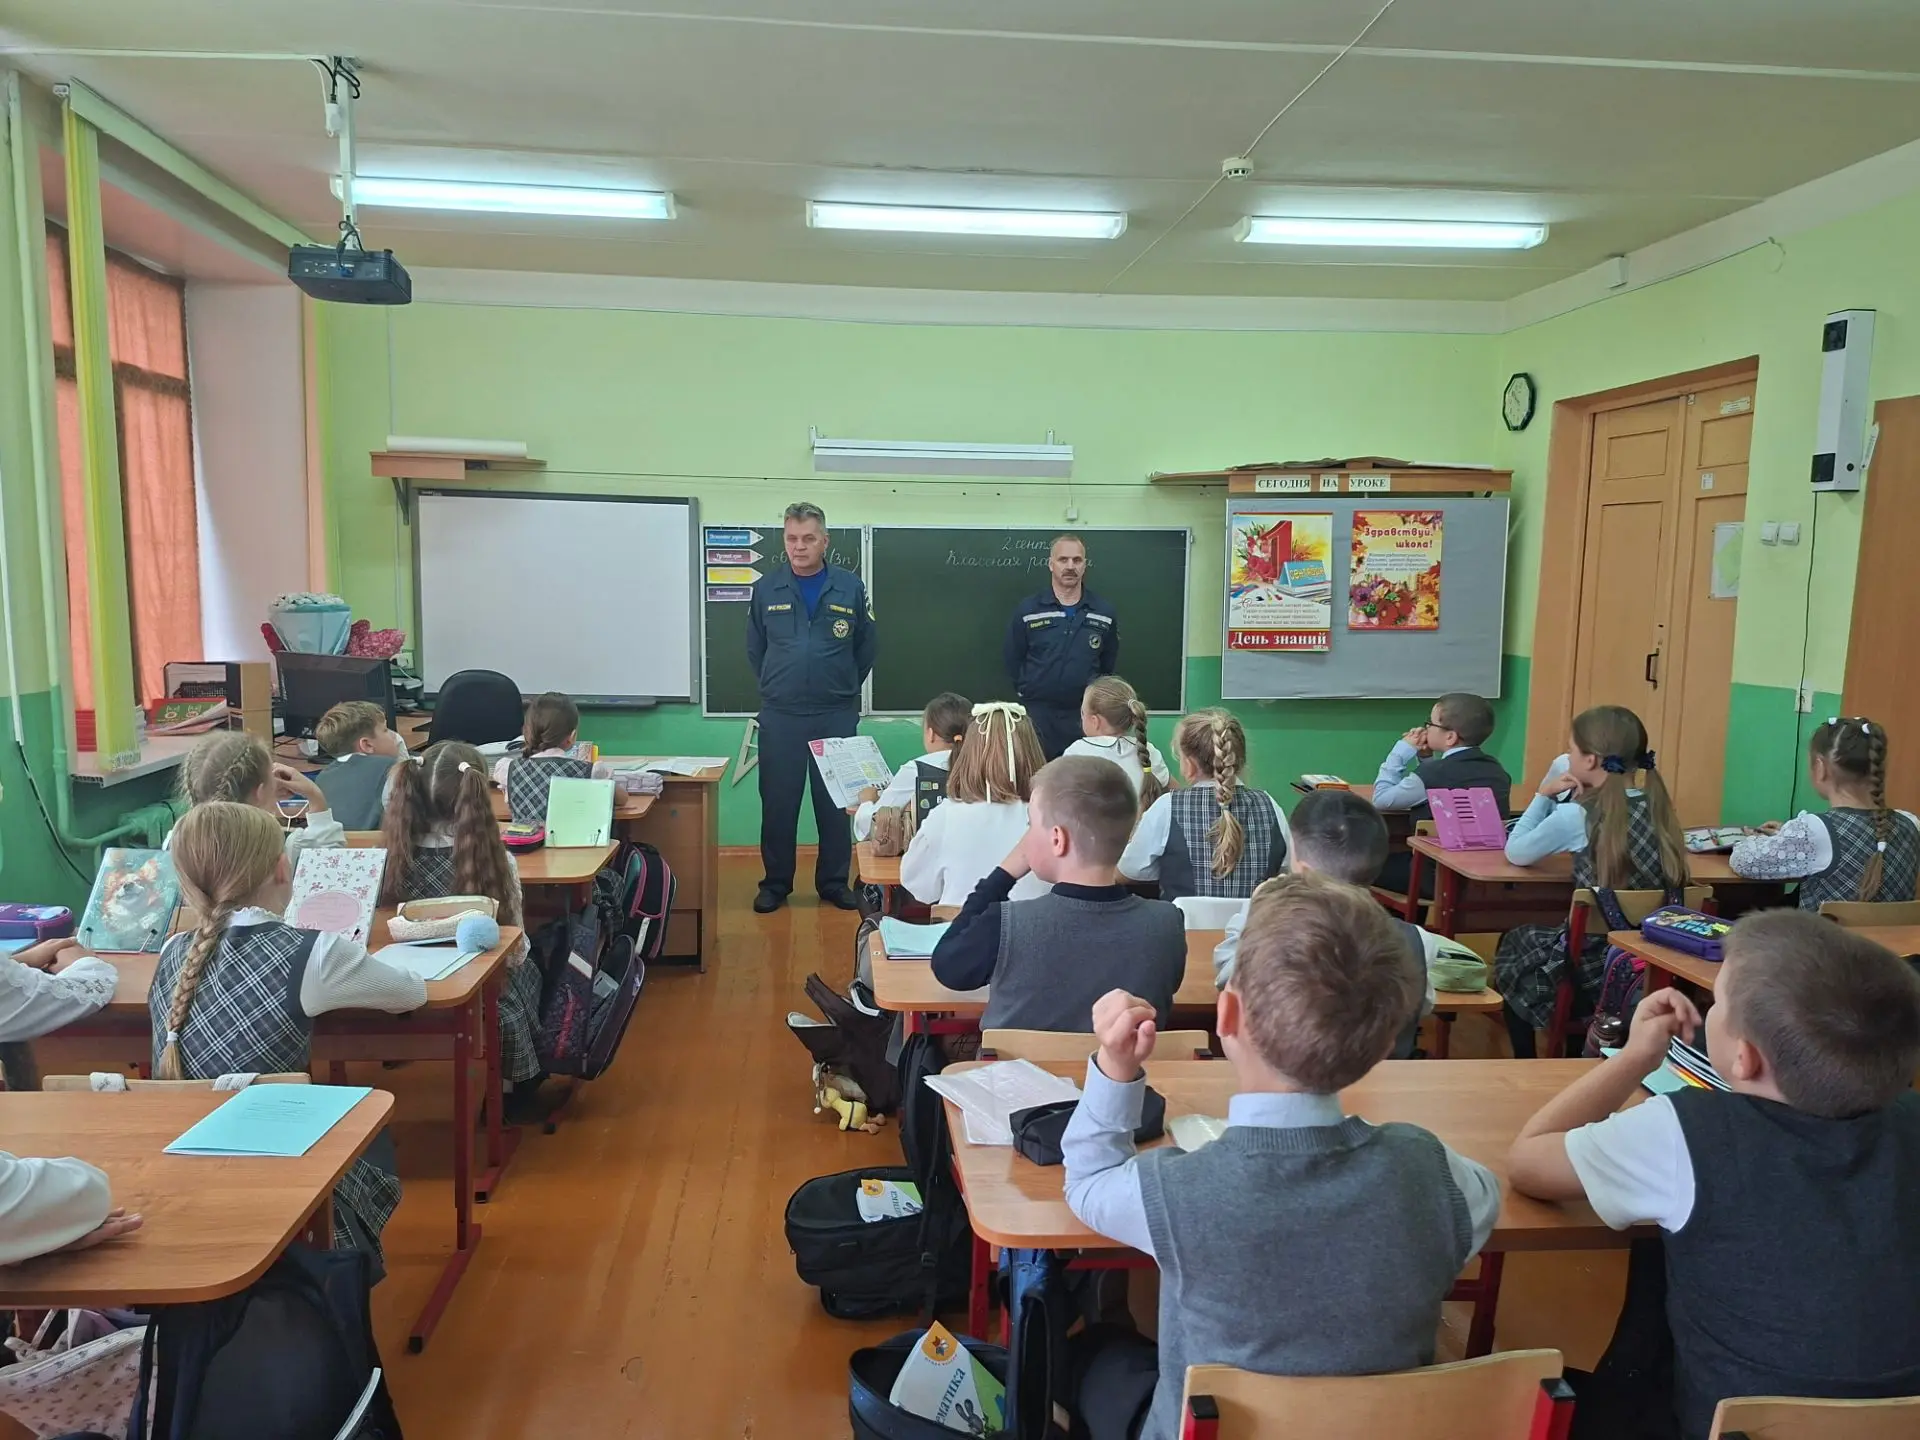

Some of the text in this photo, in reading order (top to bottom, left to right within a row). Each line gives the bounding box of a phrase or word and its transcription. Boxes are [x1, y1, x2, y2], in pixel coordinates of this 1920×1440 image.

[1257, 479, 1386, 489] СЕГОДНЯ НА УРОКЕ
[1001, 536, 1013, 550] 2
[1395, 540, 1433, 548] школа!
[1231, 632, 1327, 647] День знаний
